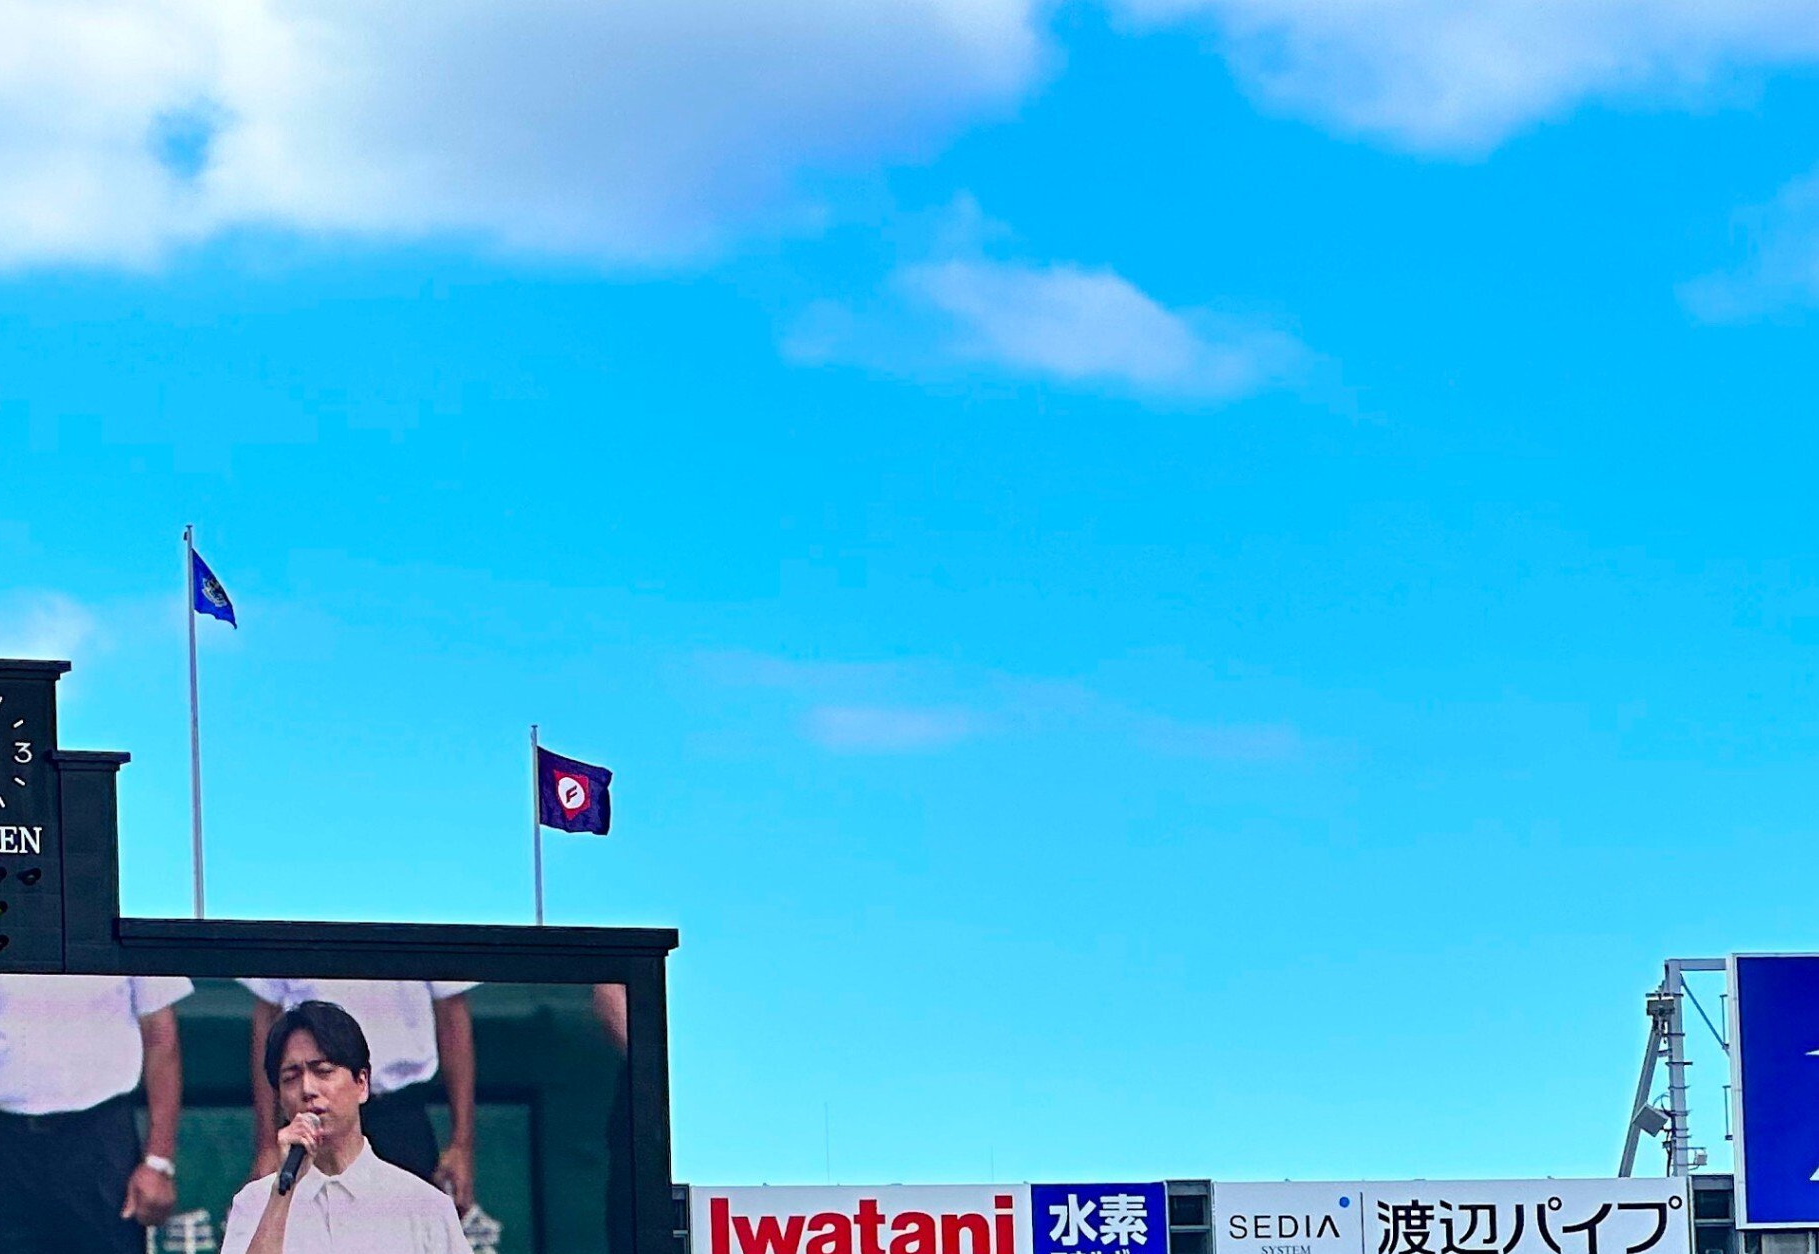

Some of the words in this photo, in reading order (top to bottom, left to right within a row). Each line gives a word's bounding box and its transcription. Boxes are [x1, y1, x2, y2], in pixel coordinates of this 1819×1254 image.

[15, 742, 32, 763] 3
[1049, 1194, 1148, 1247] 水素
[1229, 1214, 1341, 1240] SEDIA
